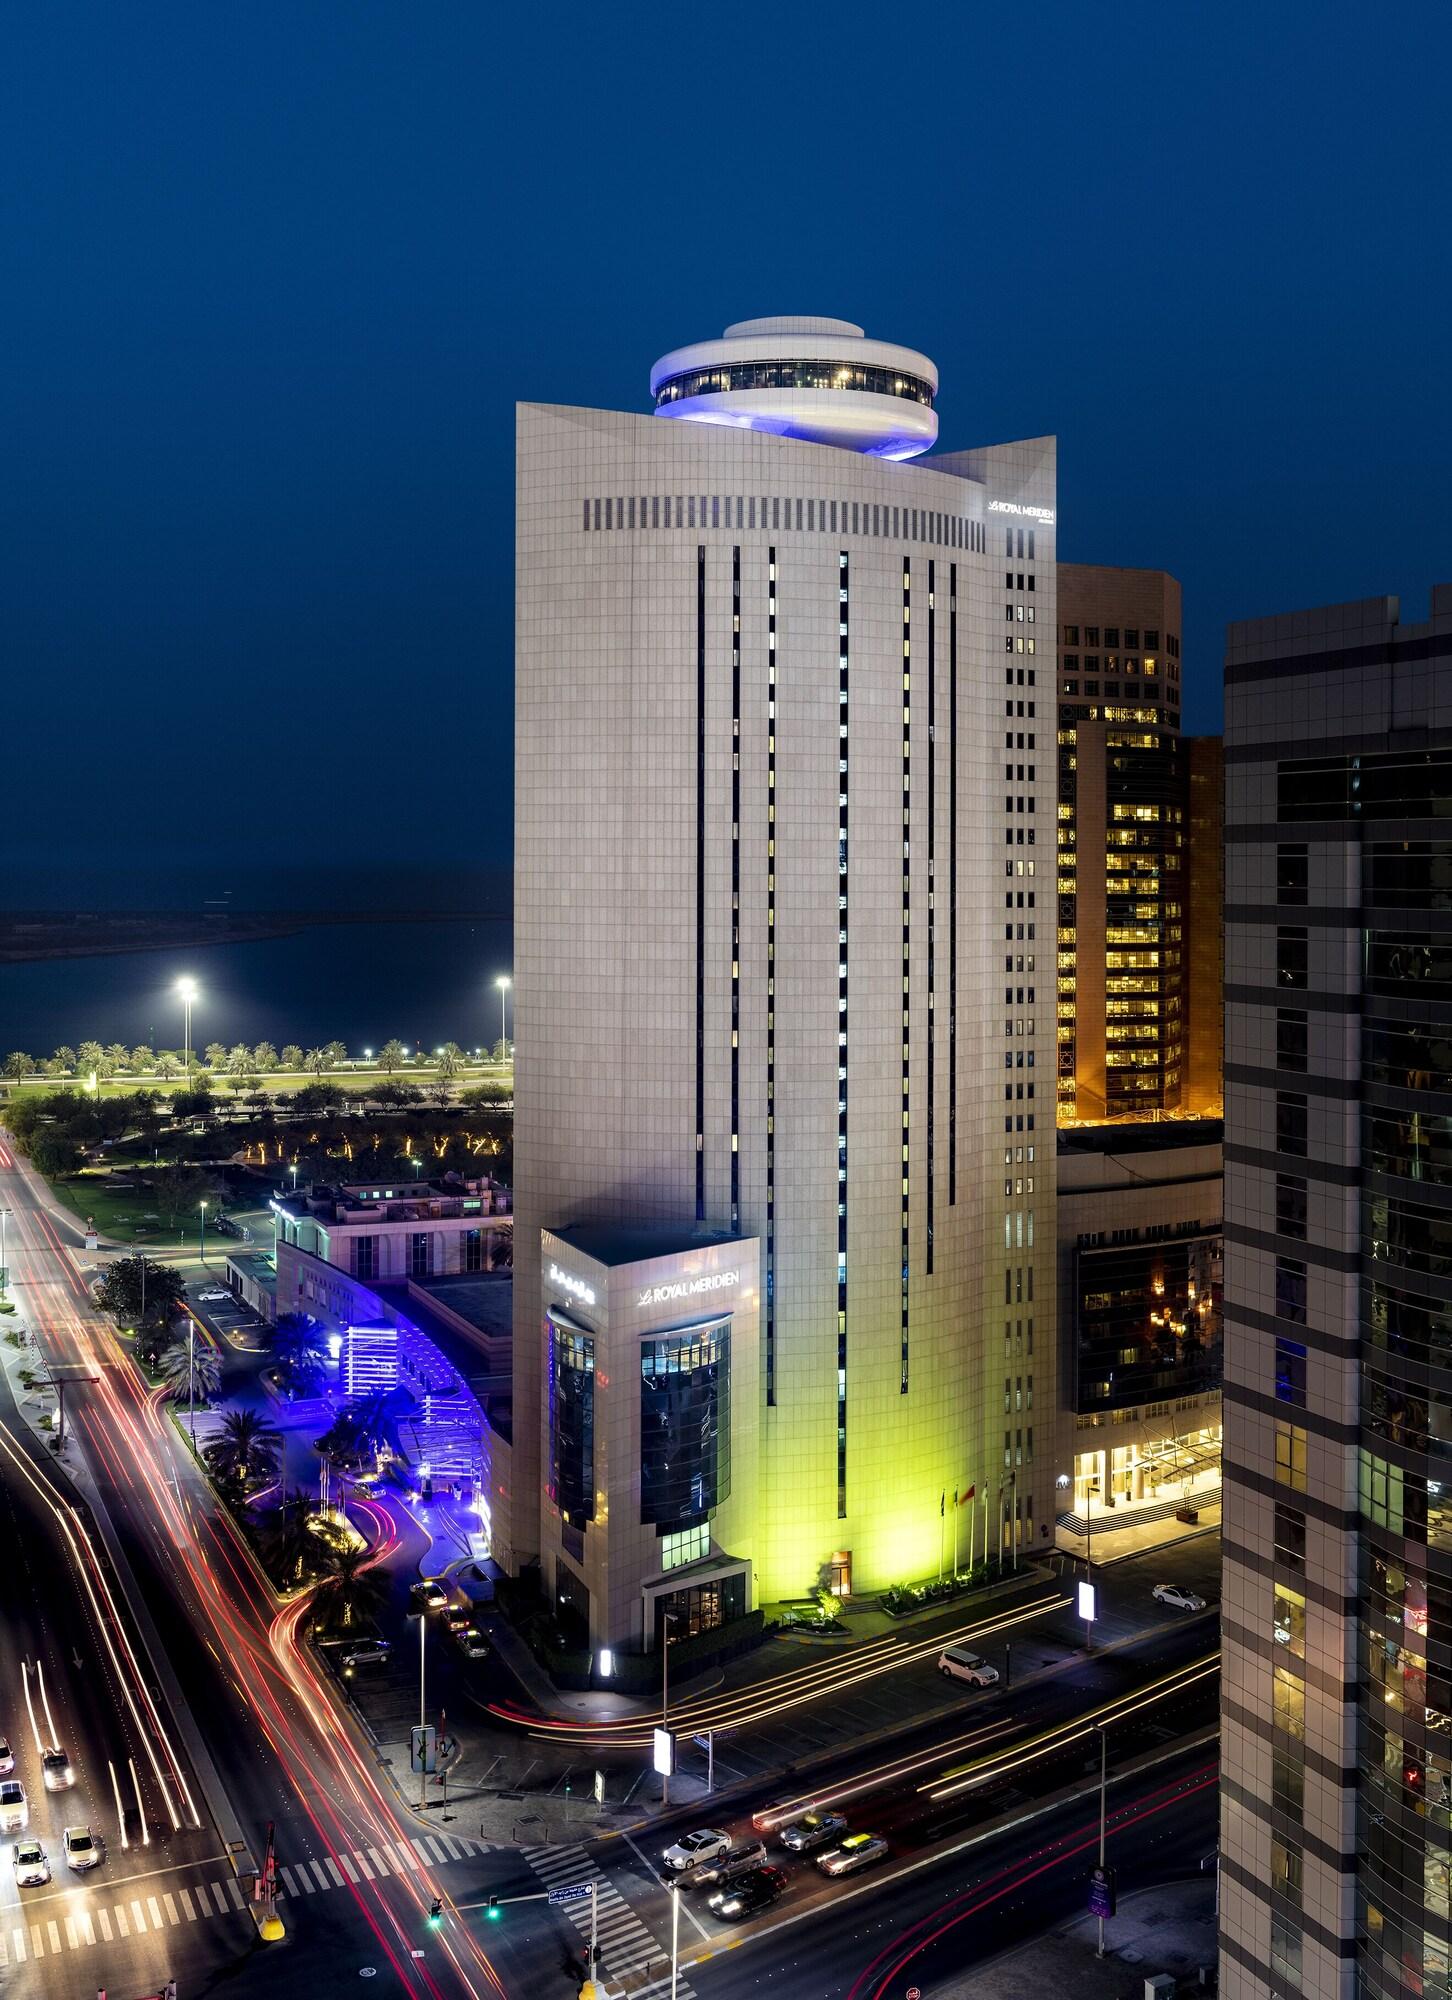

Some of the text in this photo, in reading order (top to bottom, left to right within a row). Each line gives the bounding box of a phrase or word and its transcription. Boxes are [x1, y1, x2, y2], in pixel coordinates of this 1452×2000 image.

[998, 502, 1022, 515] ROYAL
[1022, 506, 1054, 519] MERIDIEN
[638, 1270, 740, 1305] Le ROYAL MERIDIEN
